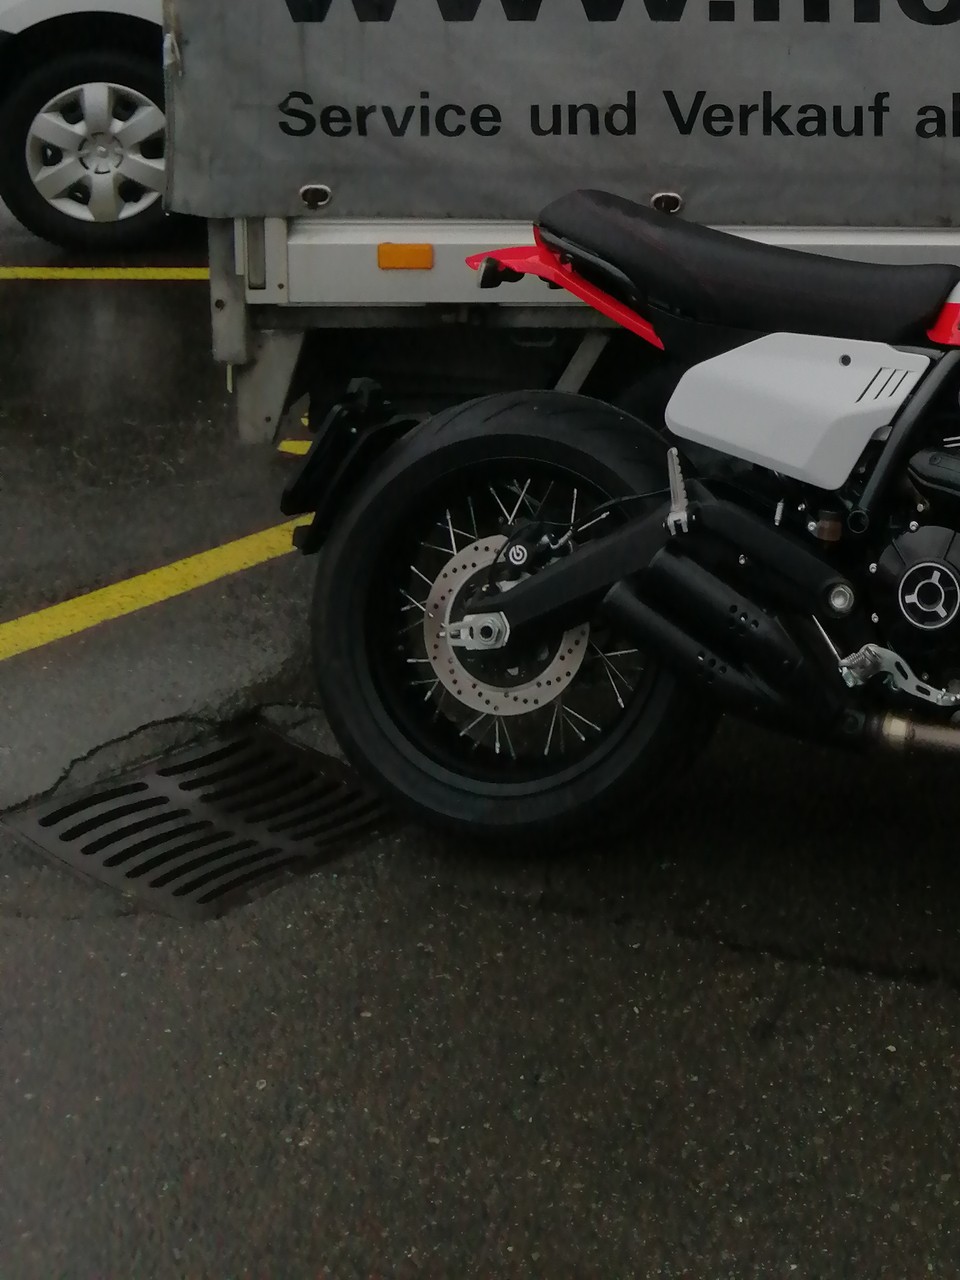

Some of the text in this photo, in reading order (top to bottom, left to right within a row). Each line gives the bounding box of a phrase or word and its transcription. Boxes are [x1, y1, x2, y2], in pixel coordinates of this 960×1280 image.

[278, 91, 502, 137] Service
[530, 91, 637, 136] und
[662, 91, 890, 137] Verkauf
